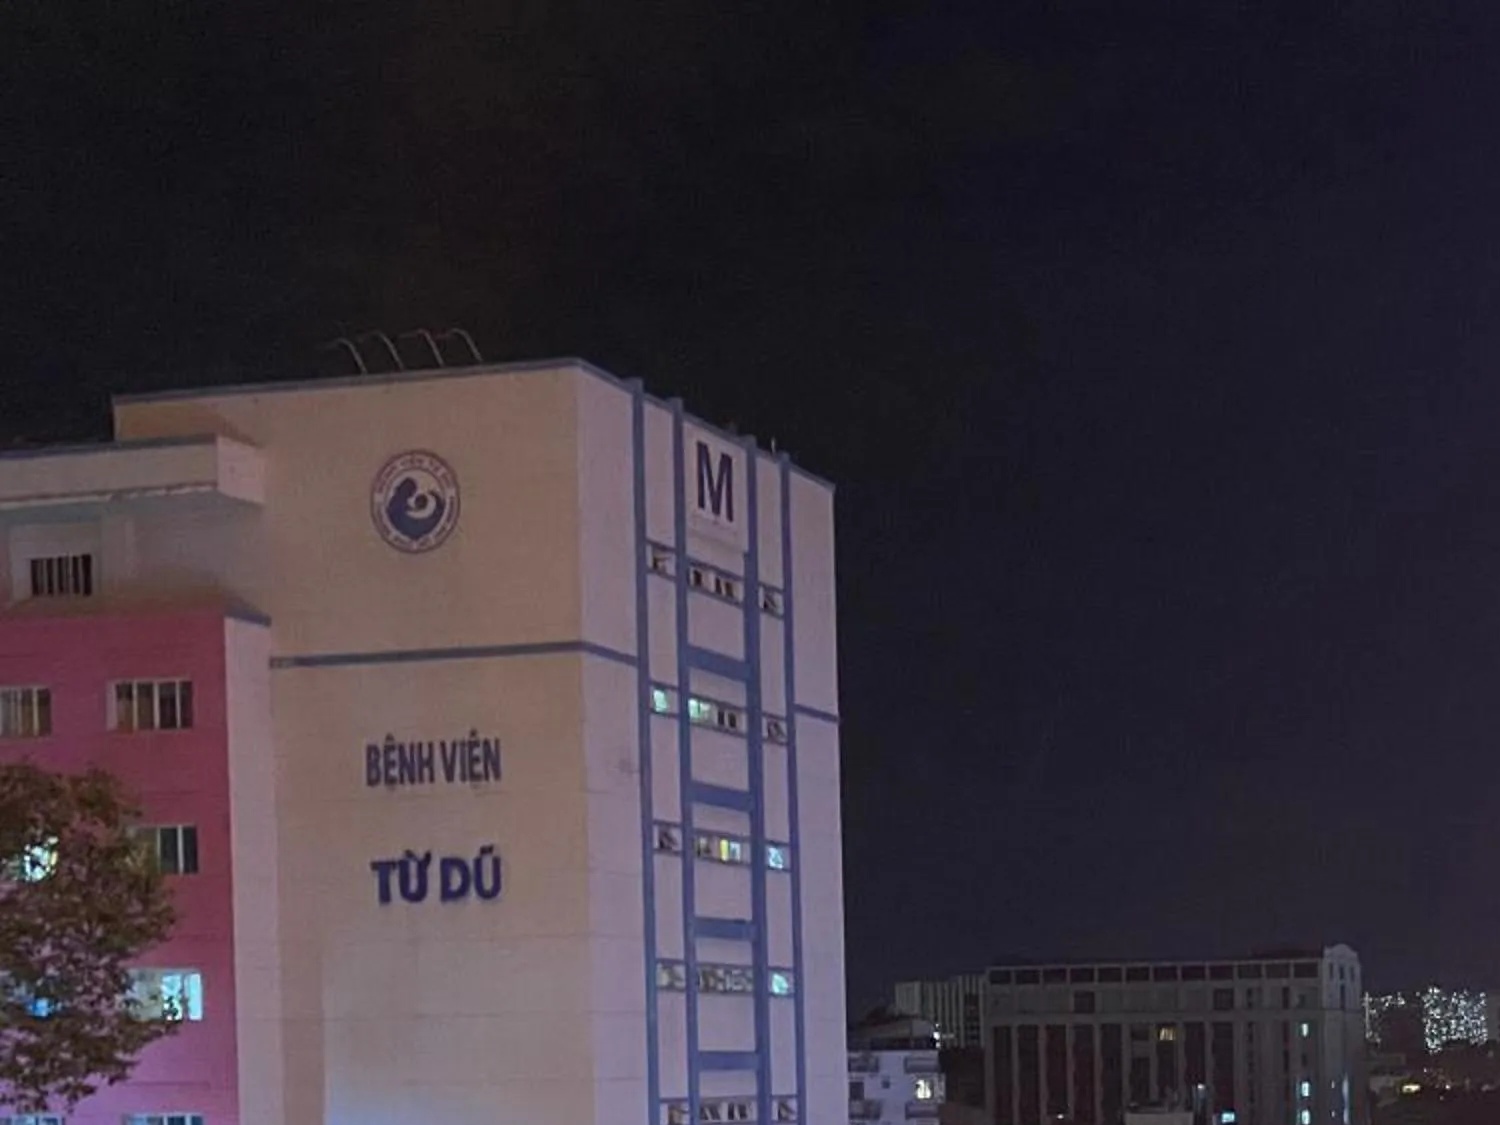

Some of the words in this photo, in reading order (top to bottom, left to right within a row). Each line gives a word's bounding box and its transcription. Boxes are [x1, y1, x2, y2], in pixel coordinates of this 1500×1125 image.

[697, 440, 733, 523] M
[370, 848, 432, 906] TỪ
[439, 842, 502, 903] DŨ
